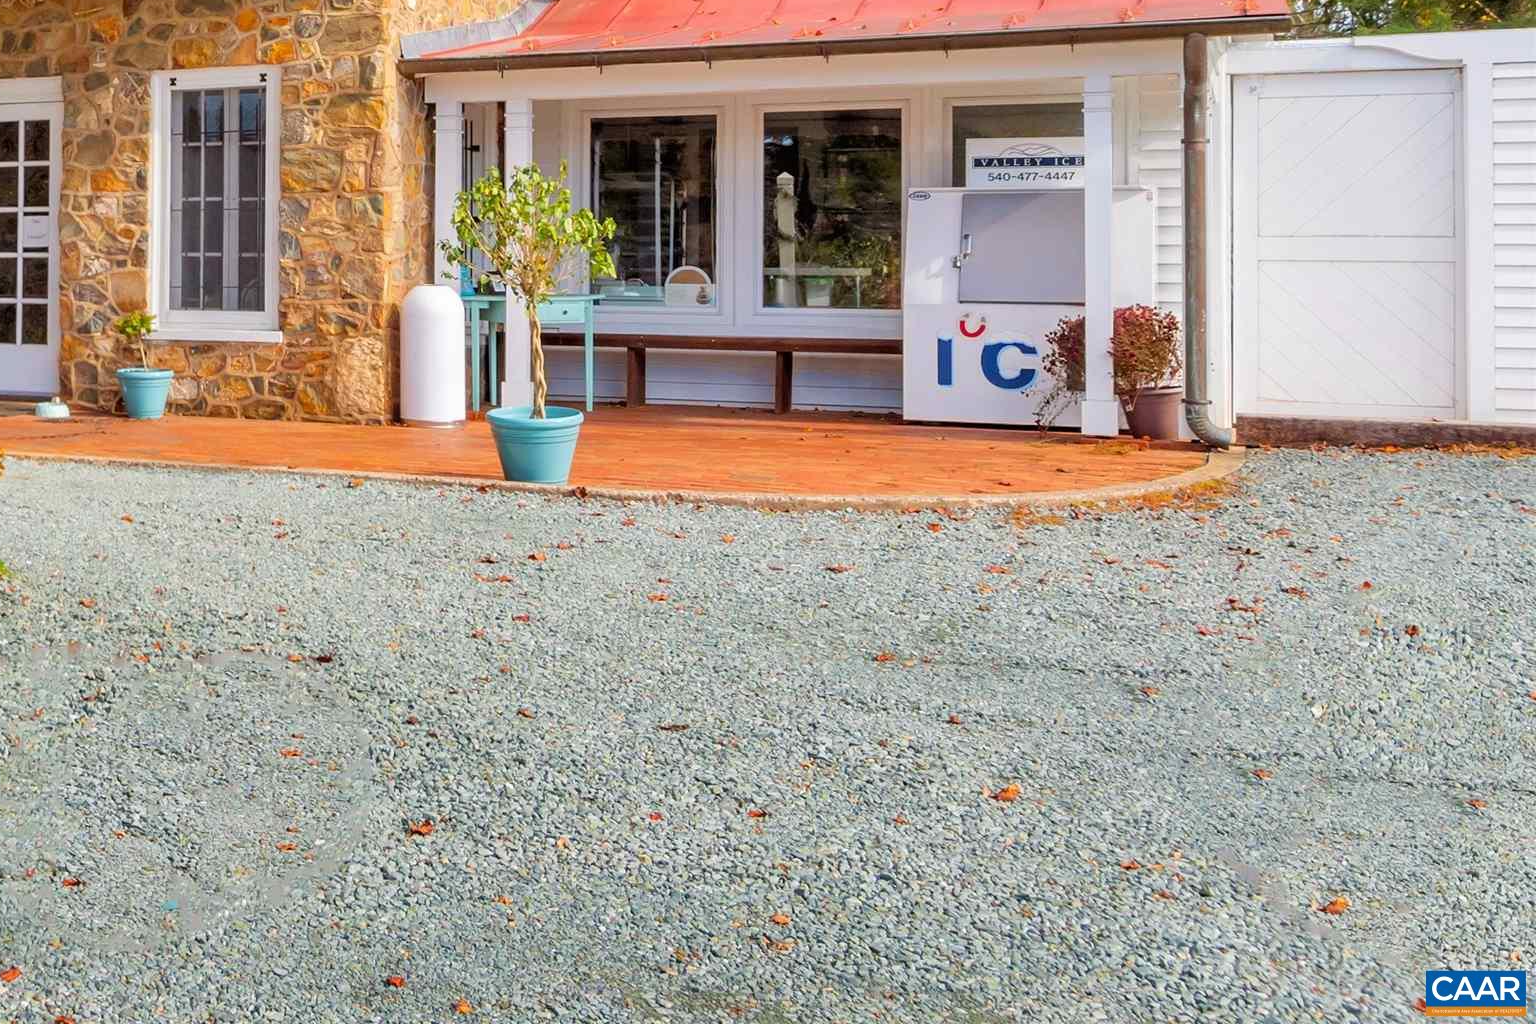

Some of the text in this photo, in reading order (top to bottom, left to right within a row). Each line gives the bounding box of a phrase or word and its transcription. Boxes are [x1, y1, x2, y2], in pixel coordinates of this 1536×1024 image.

[980, 157, 1083, 167] VALLEY ICE
[987, 171, 1076, 182] 540-477-4447
[937, 333, 1039, 390] IC
